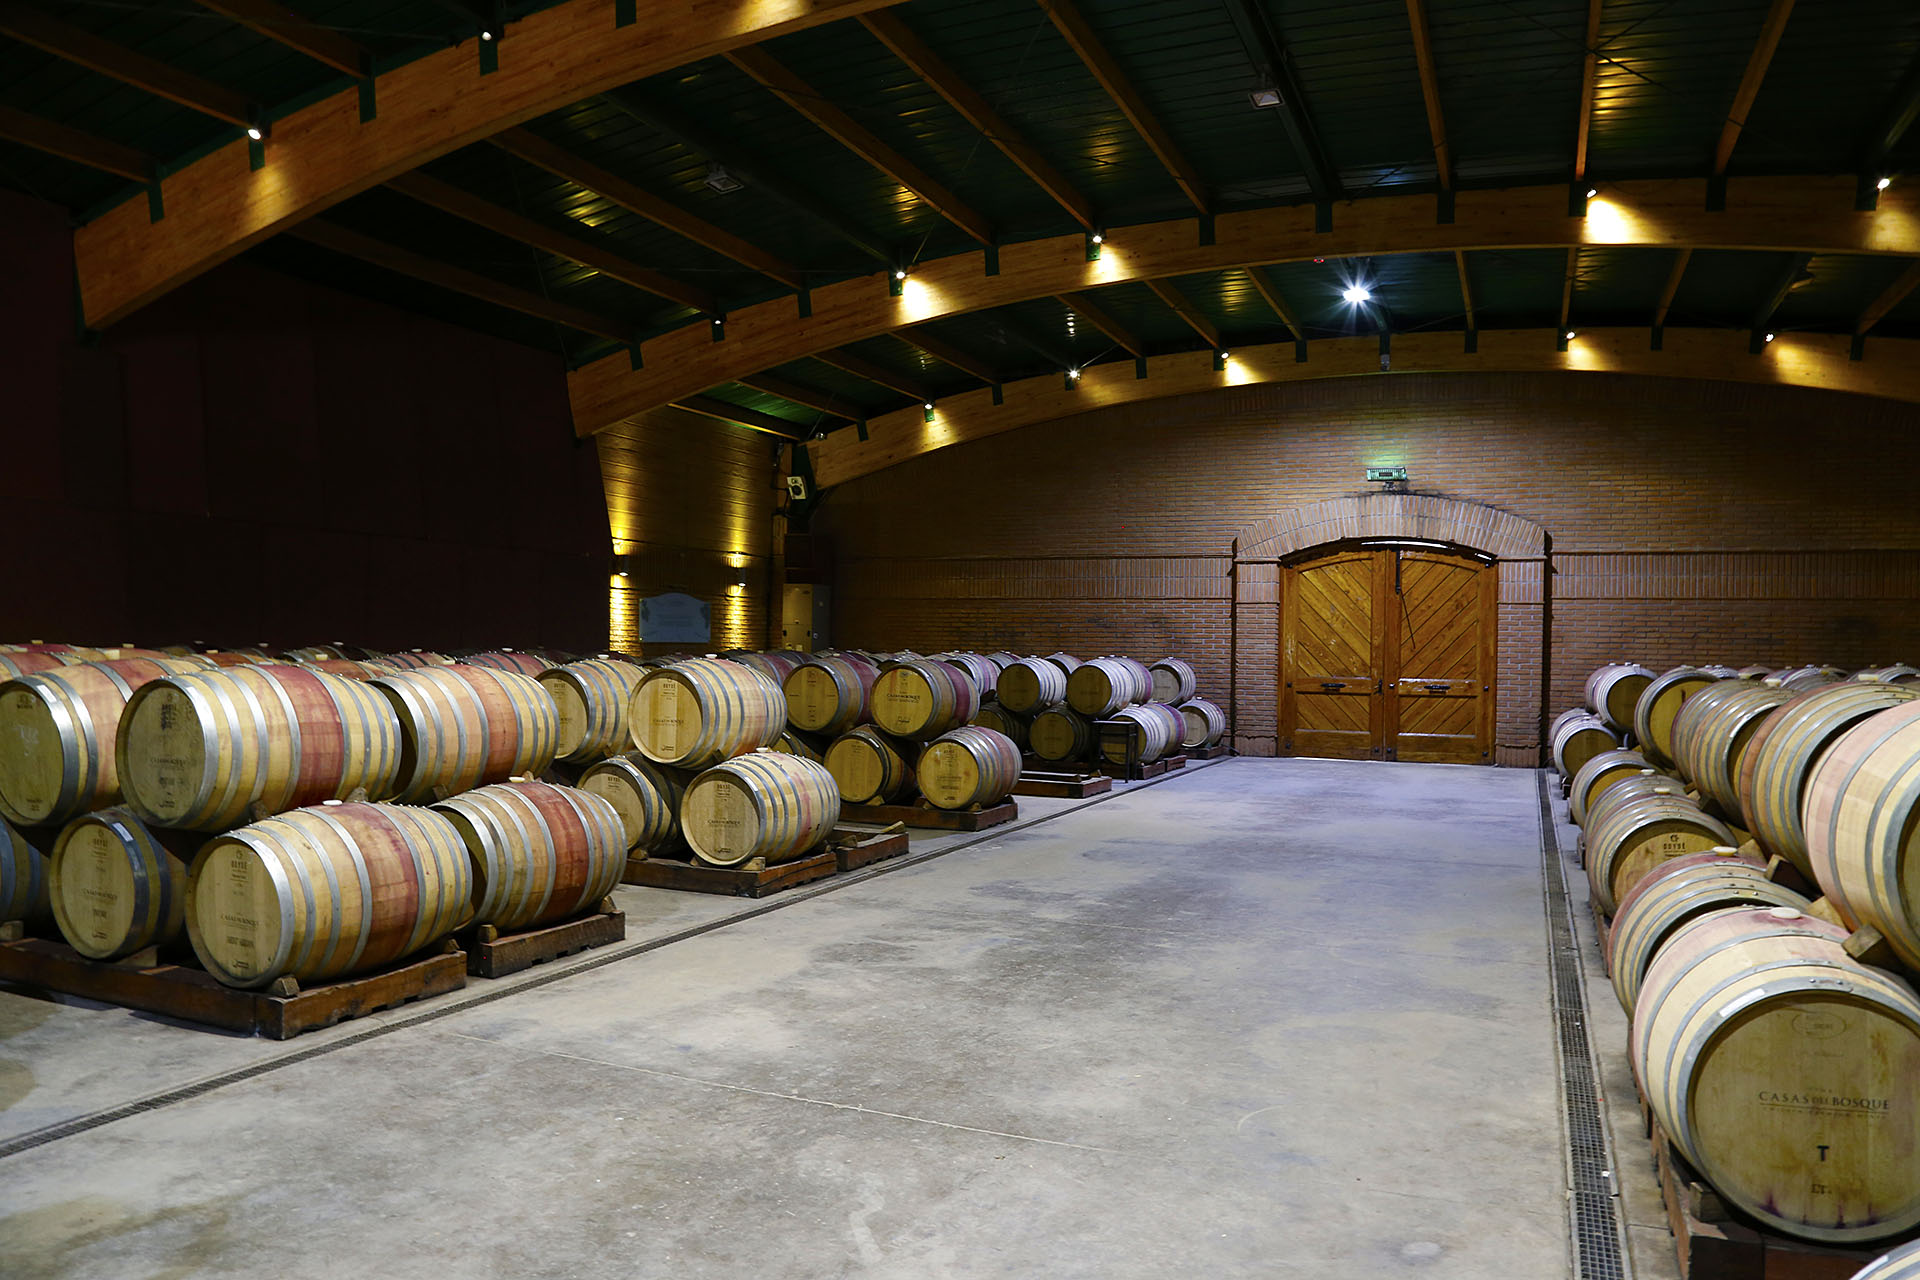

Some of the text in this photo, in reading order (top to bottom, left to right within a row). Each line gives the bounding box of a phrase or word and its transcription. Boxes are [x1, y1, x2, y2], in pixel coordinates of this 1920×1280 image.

[1759, 1091, 1809, 1104] CASAS
[1832, 1096, 1889, 1111] BOSQUE
[1817, 1145, 1830, 1162] T
